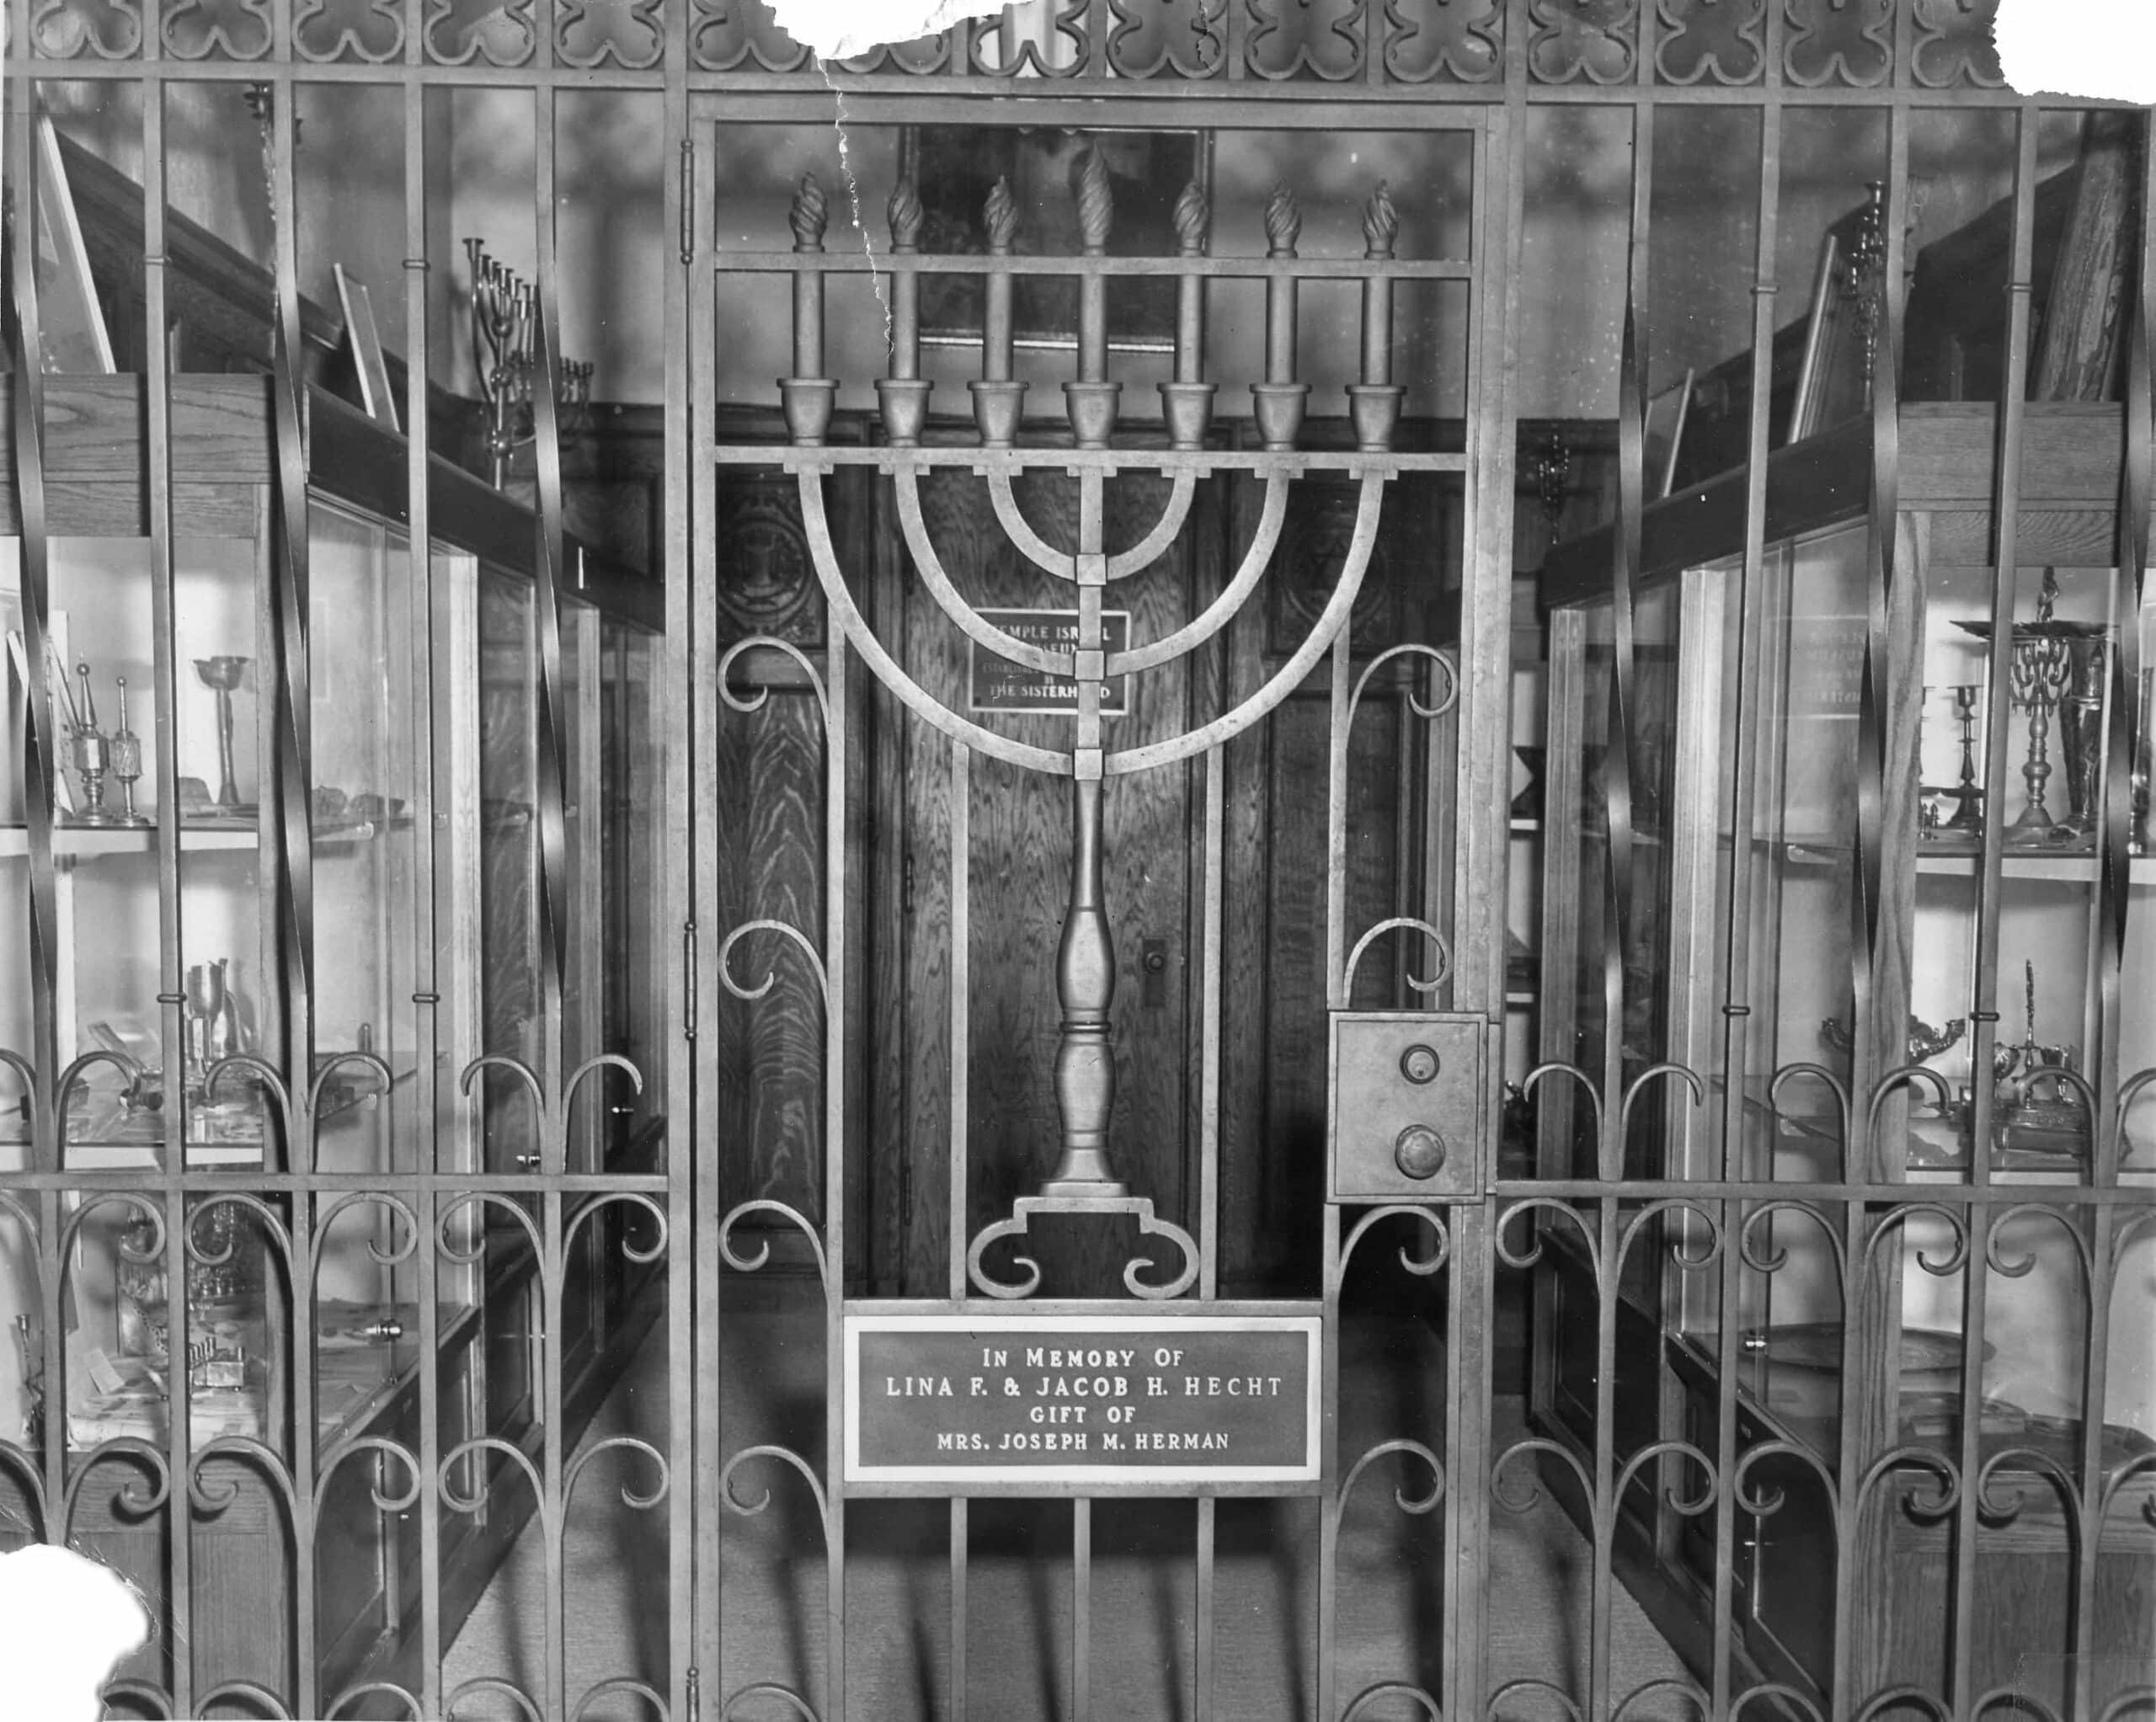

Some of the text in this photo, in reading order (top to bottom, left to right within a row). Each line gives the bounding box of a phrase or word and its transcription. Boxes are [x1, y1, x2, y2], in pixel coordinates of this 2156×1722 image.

[1056, 626, 1112, 640] ISRL
[990, 684, 1111, 699] THE SISTERHD
[984, 1347, 1182, 1367] IN MEMORY OF
[886, 1377, 1280, 1396] LINA F. & JACOB H. HECHT
[1030, 1406, 1135, 1423] GIFT OF
[937, 1433, 1228, 1450] MRS. JOSEPH M. HERMAN
